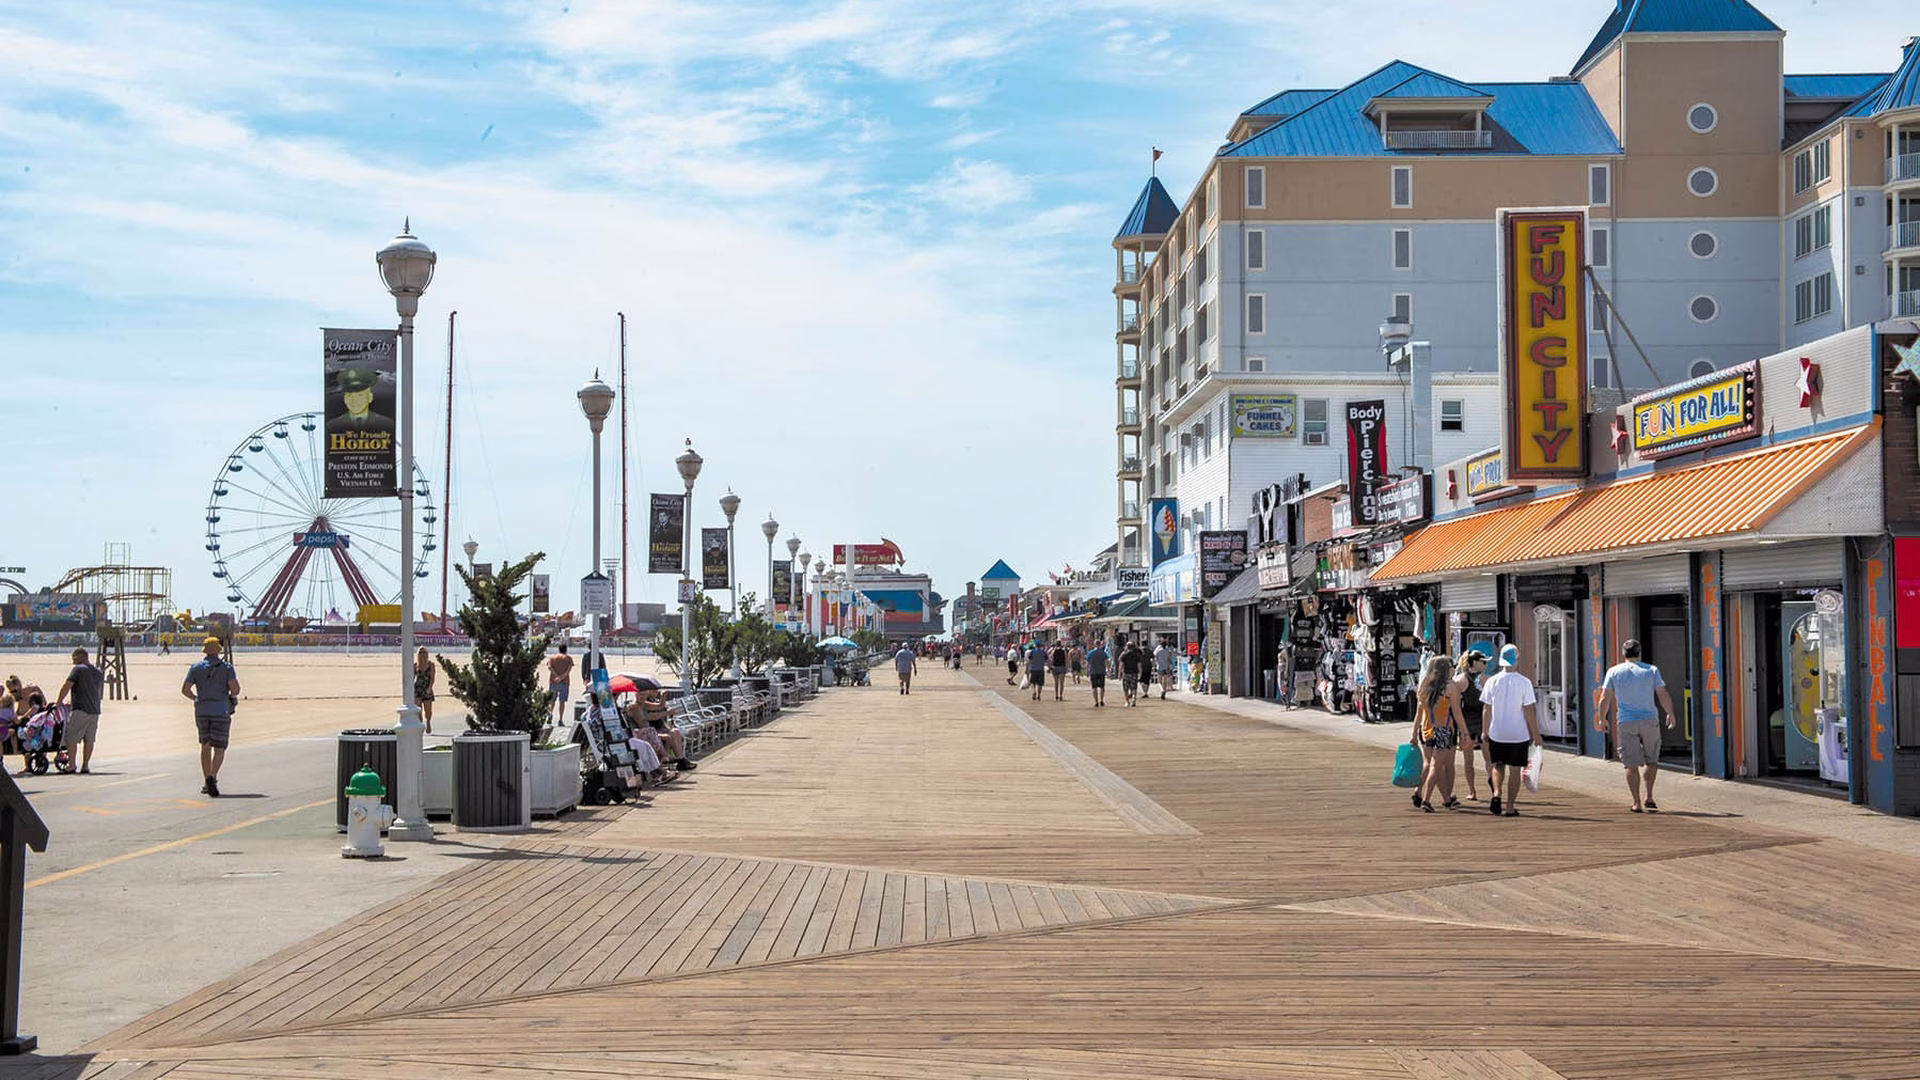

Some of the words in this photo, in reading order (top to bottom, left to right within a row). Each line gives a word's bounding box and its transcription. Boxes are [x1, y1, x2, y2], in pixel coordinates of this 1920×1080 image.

[1529, 225, 1566, 328] FUN
[328, 339, 364, 353] Ocean
[366, 339, 393, 354] City
[1529, 336, 1573, 463] CITY
[1246, 411, 1285, 422] FUNNEL
[1349, 406, 1383, 420] Body
[1640, 401, 1676, 439] FUN
[1680, 394, 1708, 429] FOR
[1710, 381, 1741, 420] ALL!
[1249, 421, 1283, 431] CAKES
[330, 433, 391, 450] Honor
[328, 462, 358, 470] PRESTON
[359, 462, 393, 470] EDMONDS
[1360, 420, 1376, 520] Piercing
[336, 471, 351, 479] U.S.
[308, 535, 335, 544] pepsi
[1867, 559, 1888, 762] PINBALL
